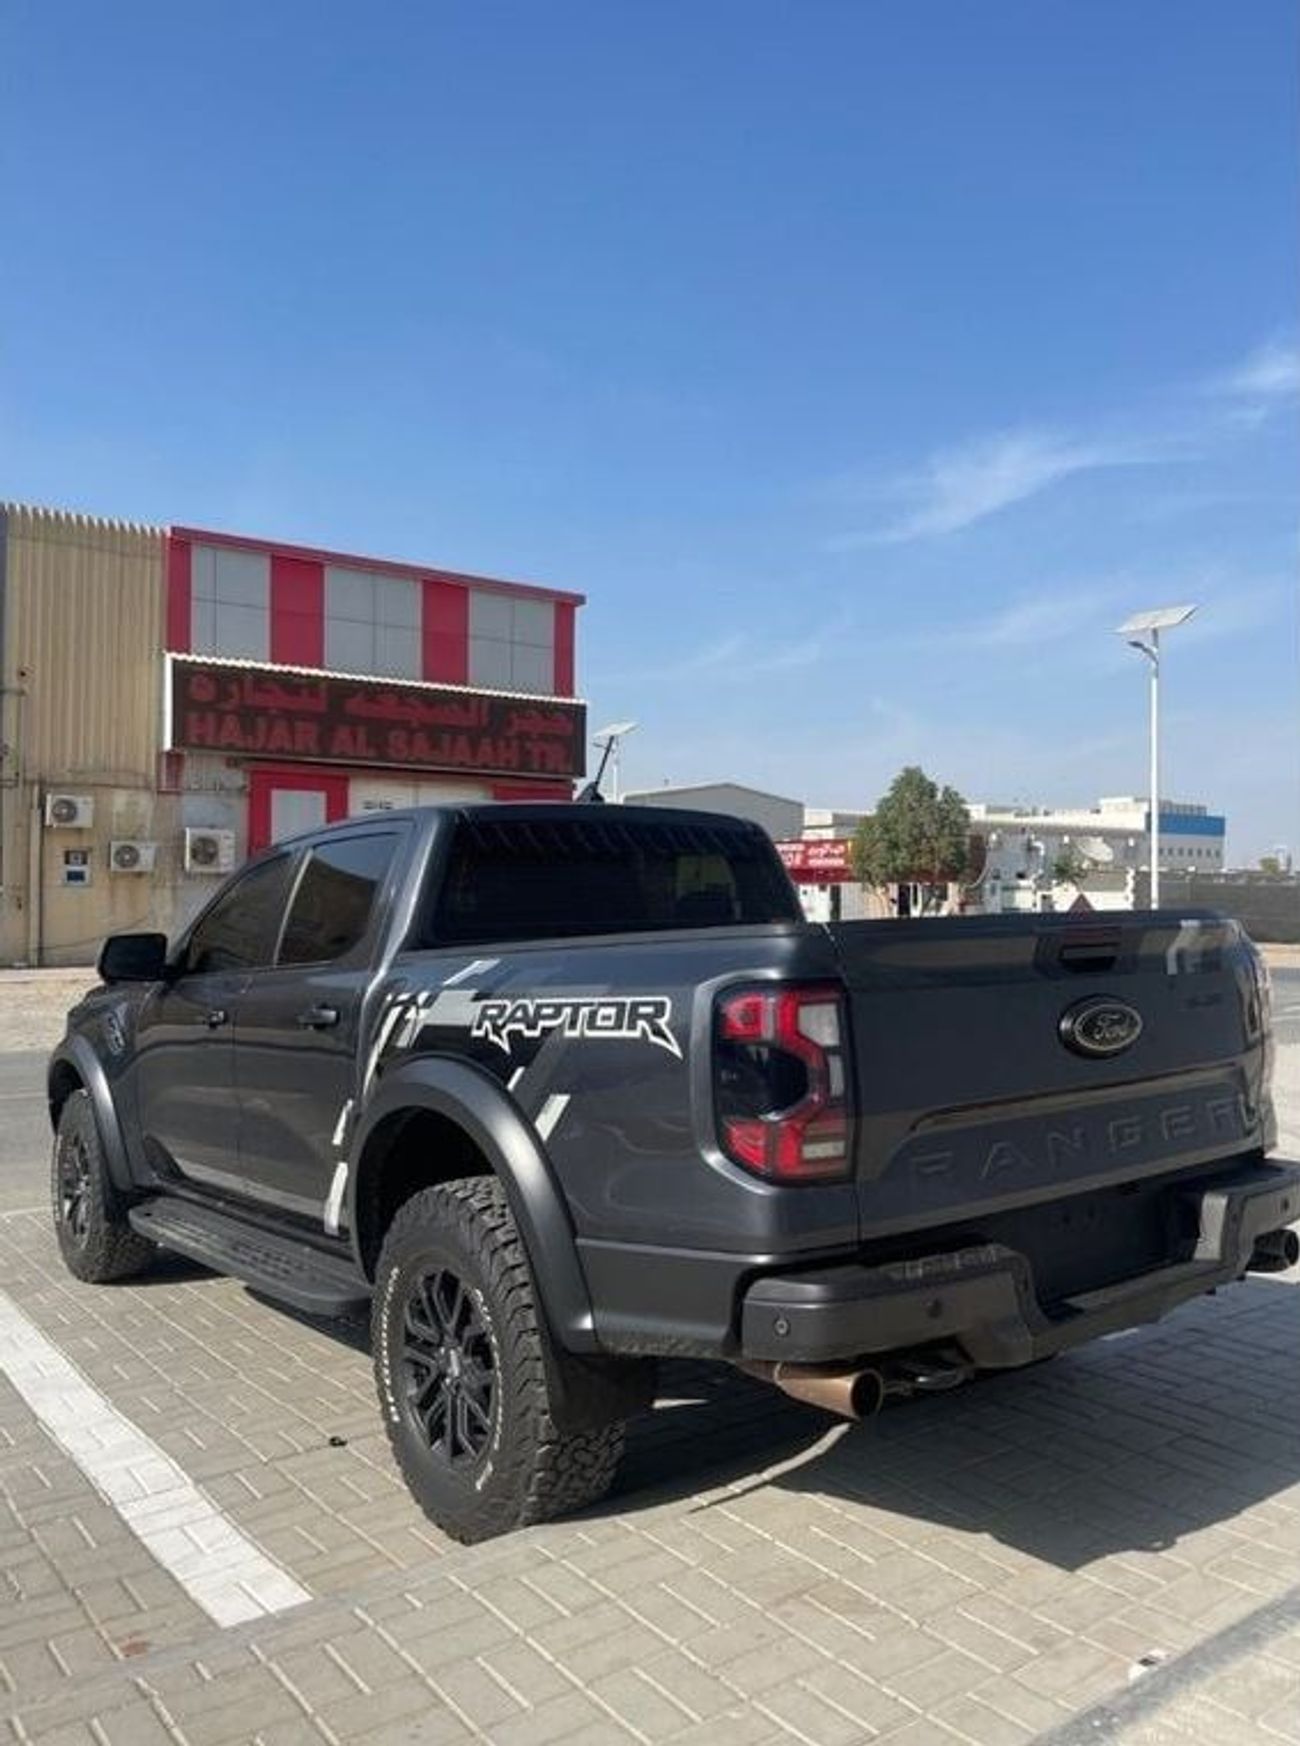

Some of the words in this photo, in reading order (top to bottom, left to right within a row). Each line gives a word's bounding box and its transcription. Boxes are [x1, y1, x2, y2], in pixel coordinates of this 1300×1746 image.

[186, 711, 318, 754] HAJAR
[331, 724, 377, 757] AL
[388, 730, 519, 768] SAJAAH
[471, 997, 684, 1060] RAPTOR
[909, 1100, 1239, 1185] RANGER
